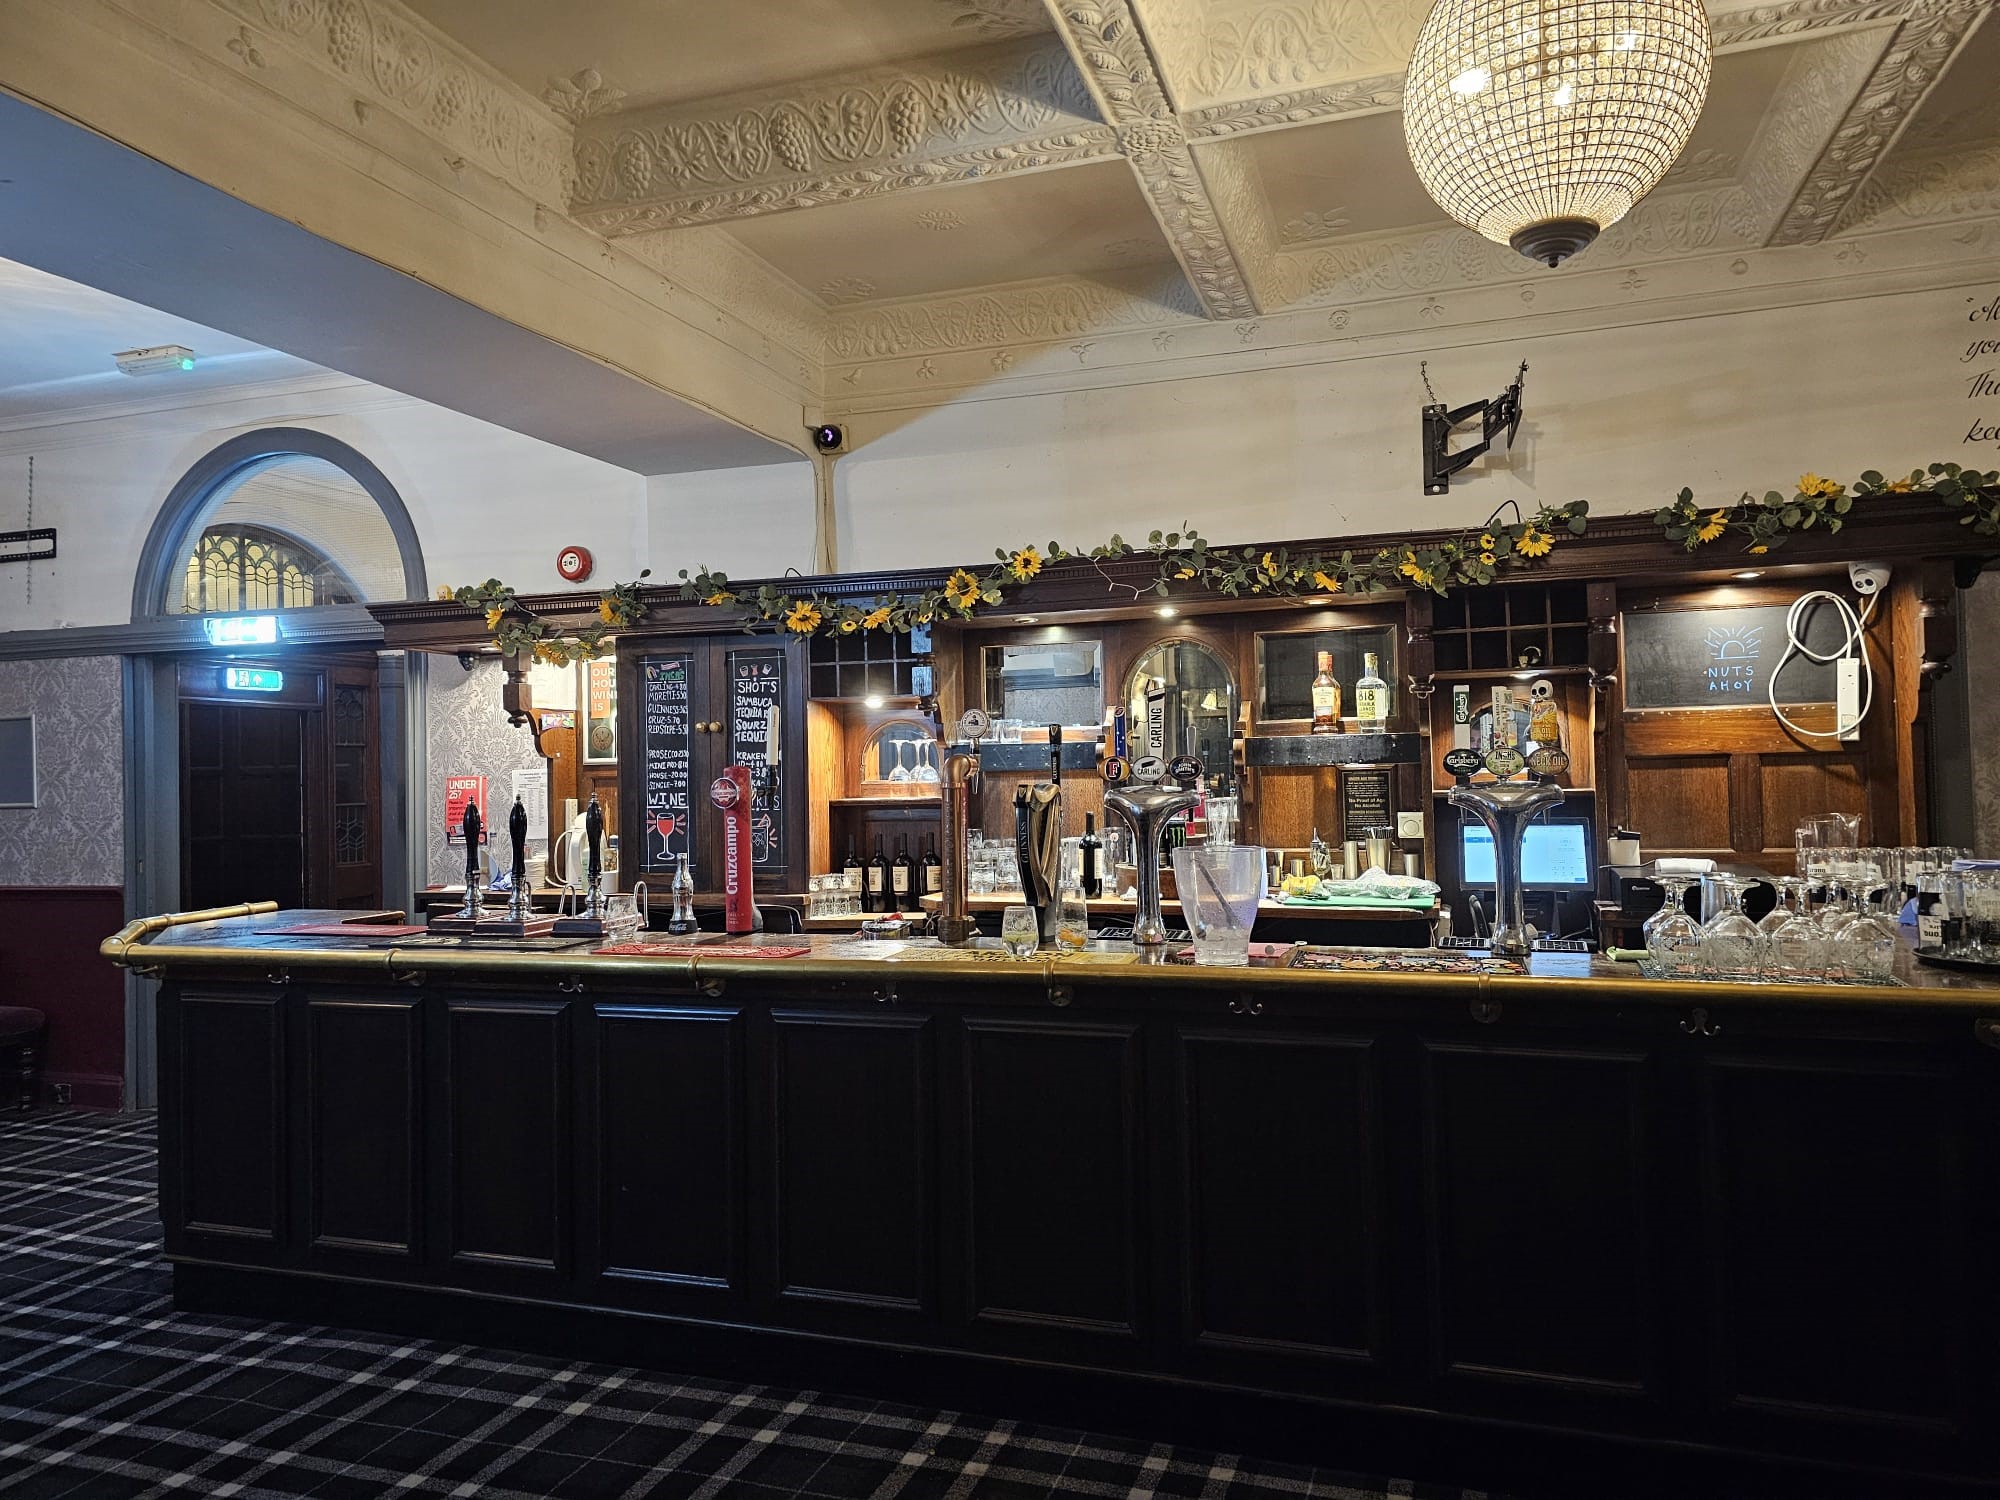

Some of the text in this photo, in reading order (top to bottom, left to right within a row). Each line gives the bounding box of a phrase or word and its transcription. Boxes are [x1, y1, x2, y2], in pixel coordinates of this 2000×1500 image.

[592, 667, 616, 677] OUR
[1708, 665, 1754, 678] NUTS
[592, 679, 617, 689] HOU
[738, 681, 777, 694] SHOT'S
[1709, 679, 1753, 692] AHOY
[736, 696, 773, 707] SAMBUCA
[1359, 690, 1375, 701] 818
[594, 702, 604, 712] IS
[1151, 708, 1162, 748] CARLING
[1446, 754, 1479, 768] Carlsberg
[1109, 762, 1120, 778] F
[1137, 768, 1161, 776] CARLING
[449, 780, 477, 789] UNDER
[449, 790, 463, 800] 25?
[649, 793, 687, 806] WINE
[726, 816, 740, 896] Cruzcampo
